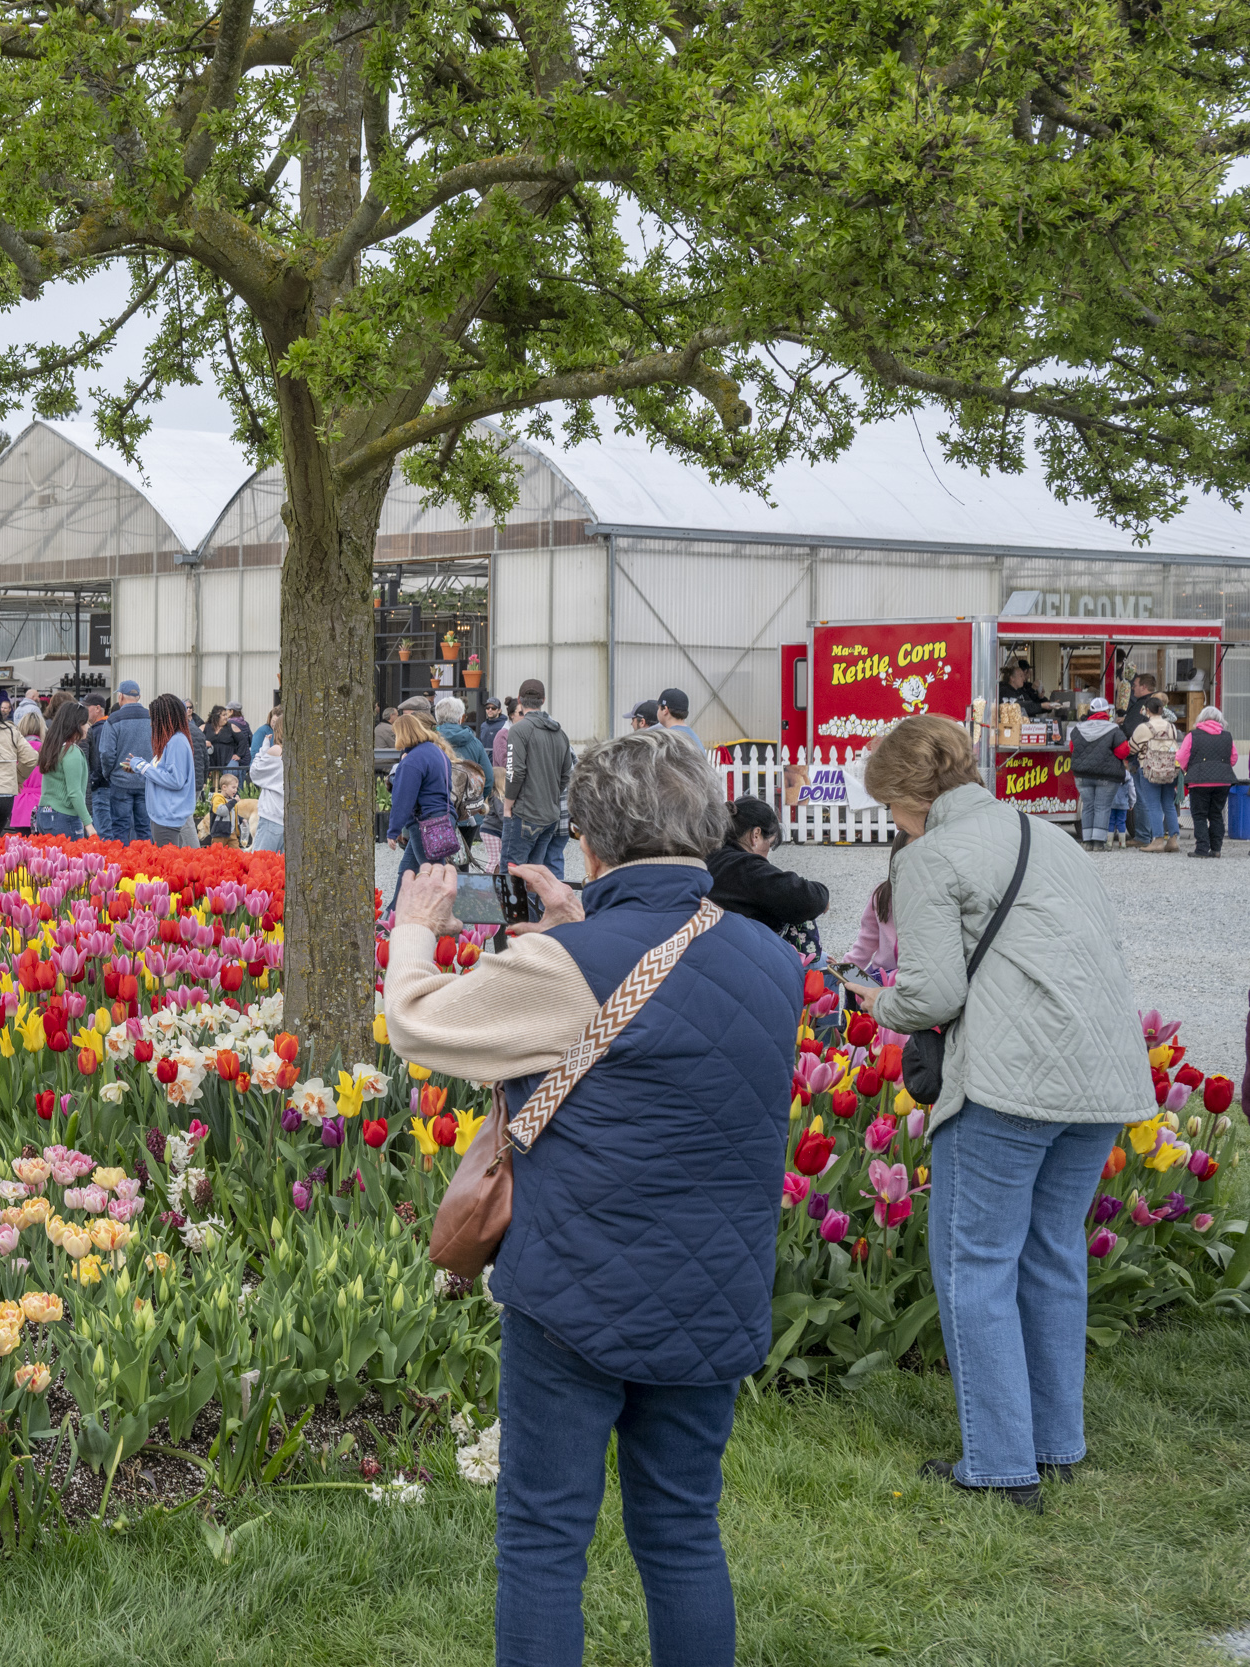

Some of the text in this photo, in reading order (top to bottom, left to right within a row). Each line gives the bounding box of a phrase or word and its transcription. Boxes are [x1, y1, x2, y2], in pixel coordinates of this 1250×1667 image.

[831, 640, 947, 685] Kettle Corn
[1005, 755, 1071, 795] Kettle Co
